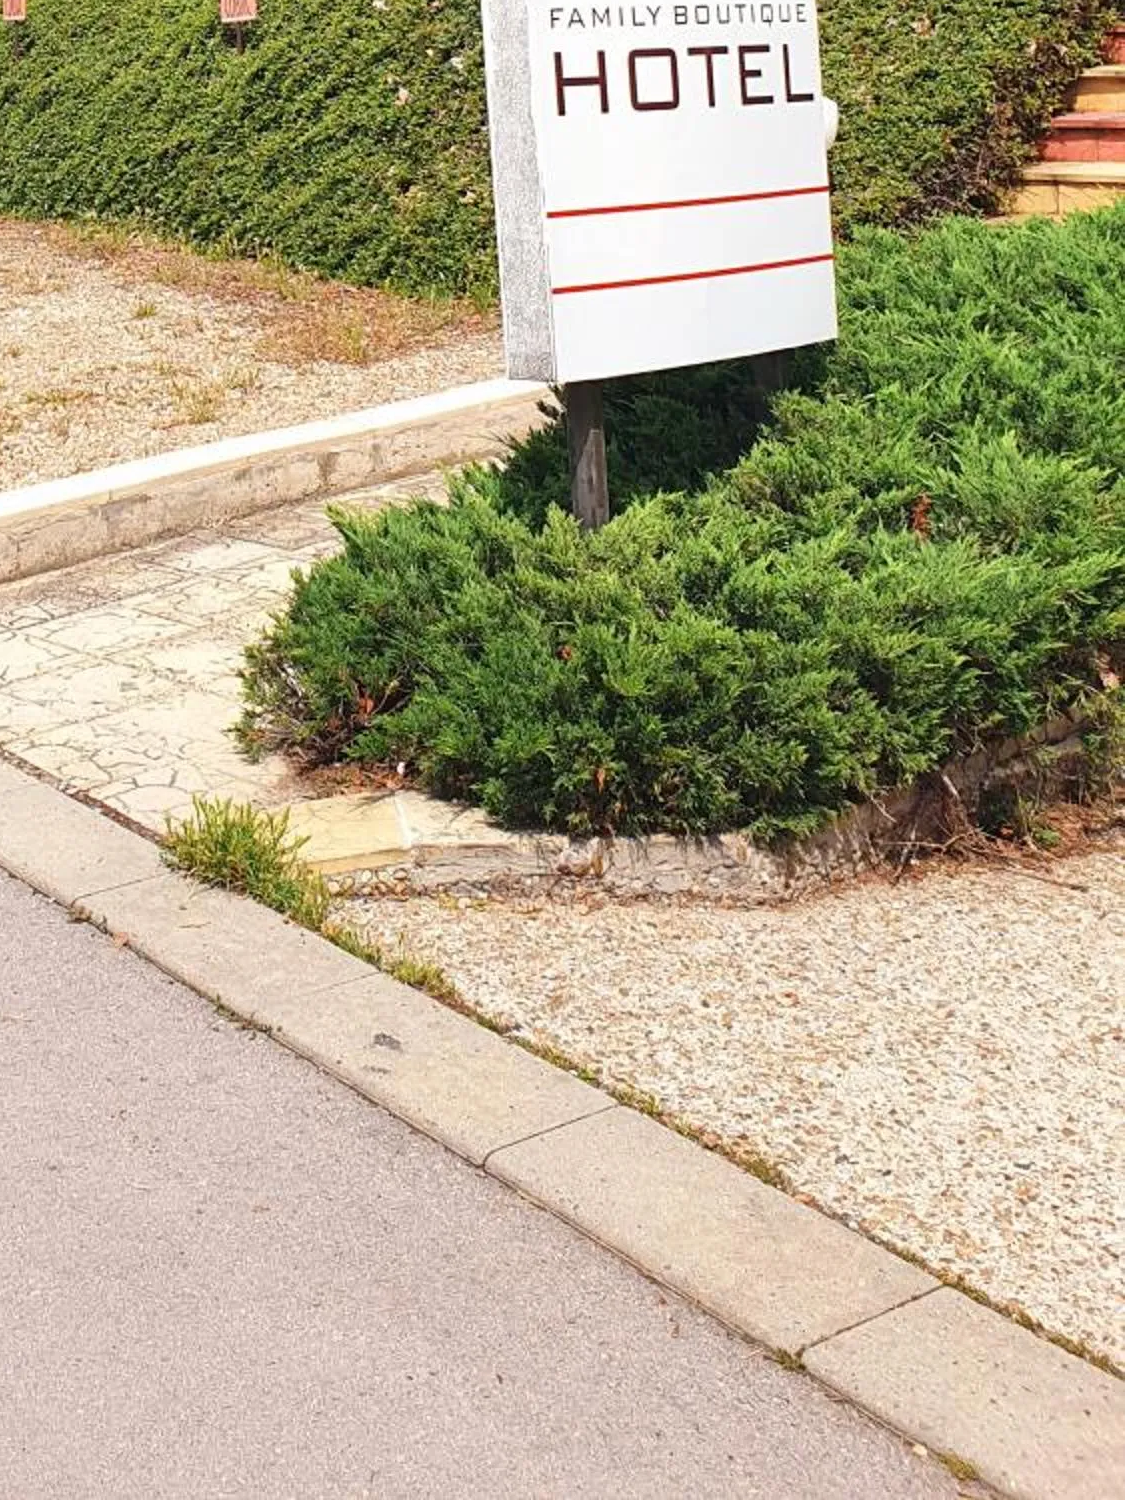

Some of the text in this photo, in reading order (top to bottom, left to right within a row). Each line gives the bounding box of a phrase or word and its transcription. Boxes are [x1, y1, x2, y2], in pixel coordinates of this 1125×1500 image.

[550, 4, 807, 28] FAMILY BOUTIQUE
[554, 44, 814, 116] HOTEL
